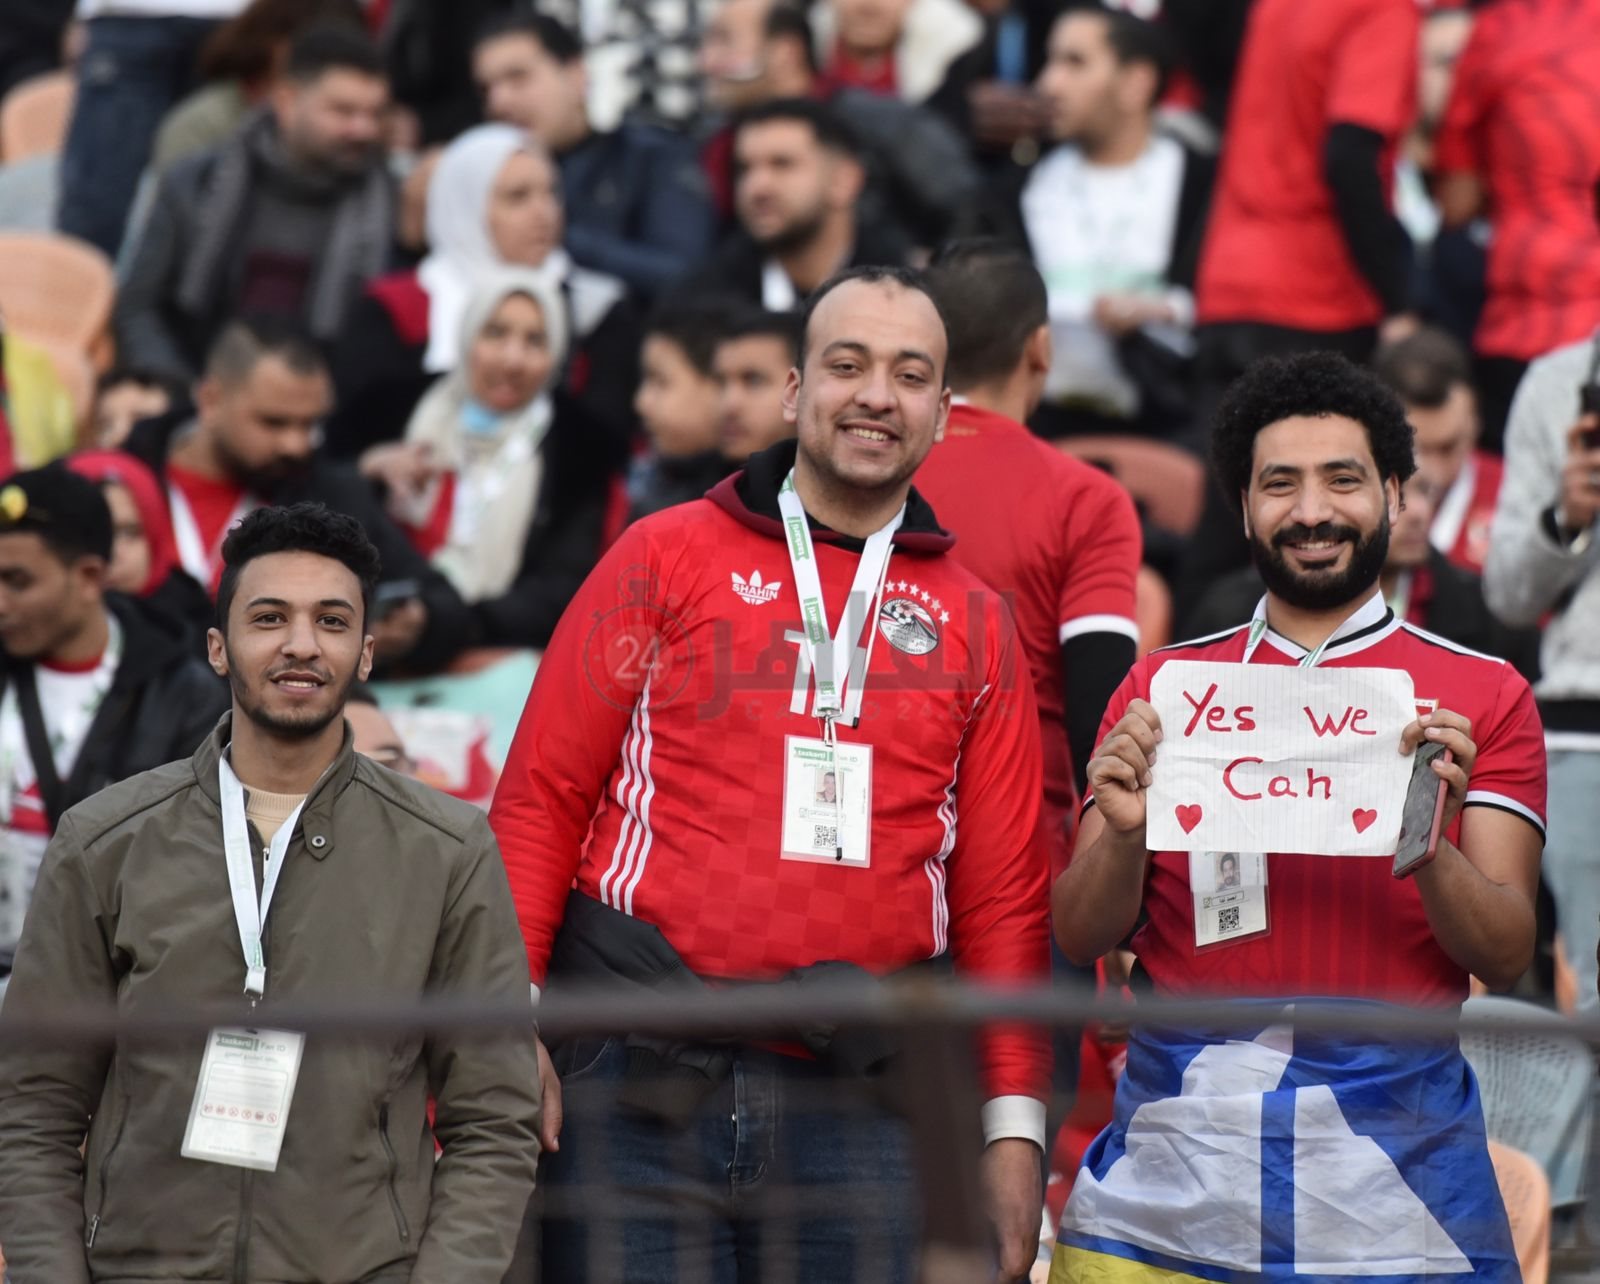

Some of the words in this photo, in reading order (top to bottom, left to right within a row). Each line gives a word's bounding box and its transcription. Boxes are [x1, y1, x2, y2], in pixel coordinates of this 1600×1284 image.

[732, 583, 778, 600] SHAHIN
[1182, 683, 1256, 737] Yes
[1303, 705, 1377, 738] We
[1222, 756, 1332, 801] Can
